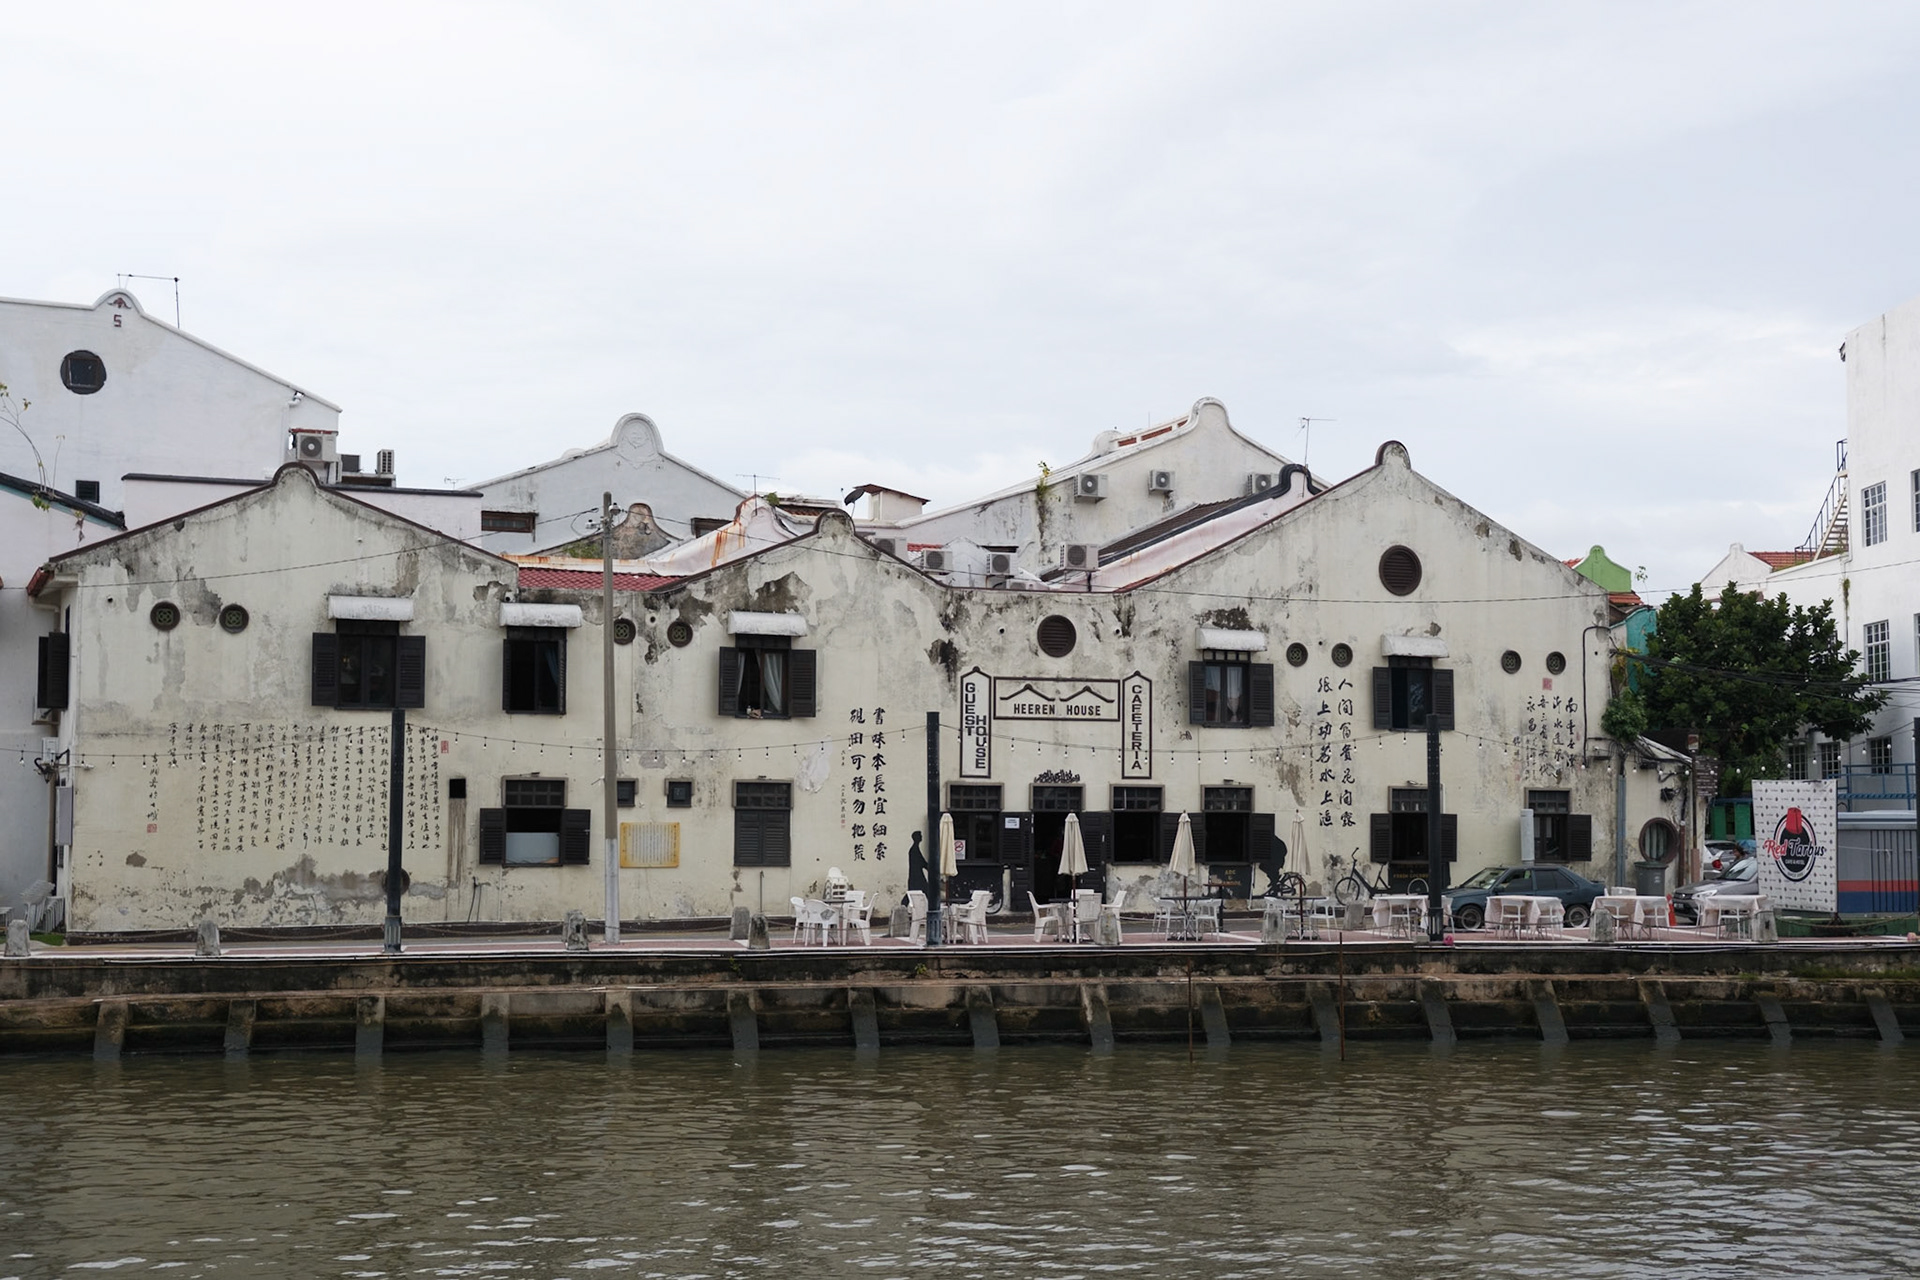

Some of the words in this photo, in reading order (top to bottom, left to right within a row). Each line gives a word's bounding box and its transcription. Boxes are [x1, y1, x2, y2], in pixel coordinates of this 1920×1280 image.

[113, 313, 122, 328] 5
[1013, 703, 1056, 715] HEEREN
[1066, 705, 1101, 716] HOUSE
[965, 682, 976, 736] GUEST
[976, 715, 987, 769] HOUSE
[1131, 684, 1143, 770] CAFETERIA
[1764, 839, 1788, 860] Red
[1788, 837, 1826, 857] Tarbus
